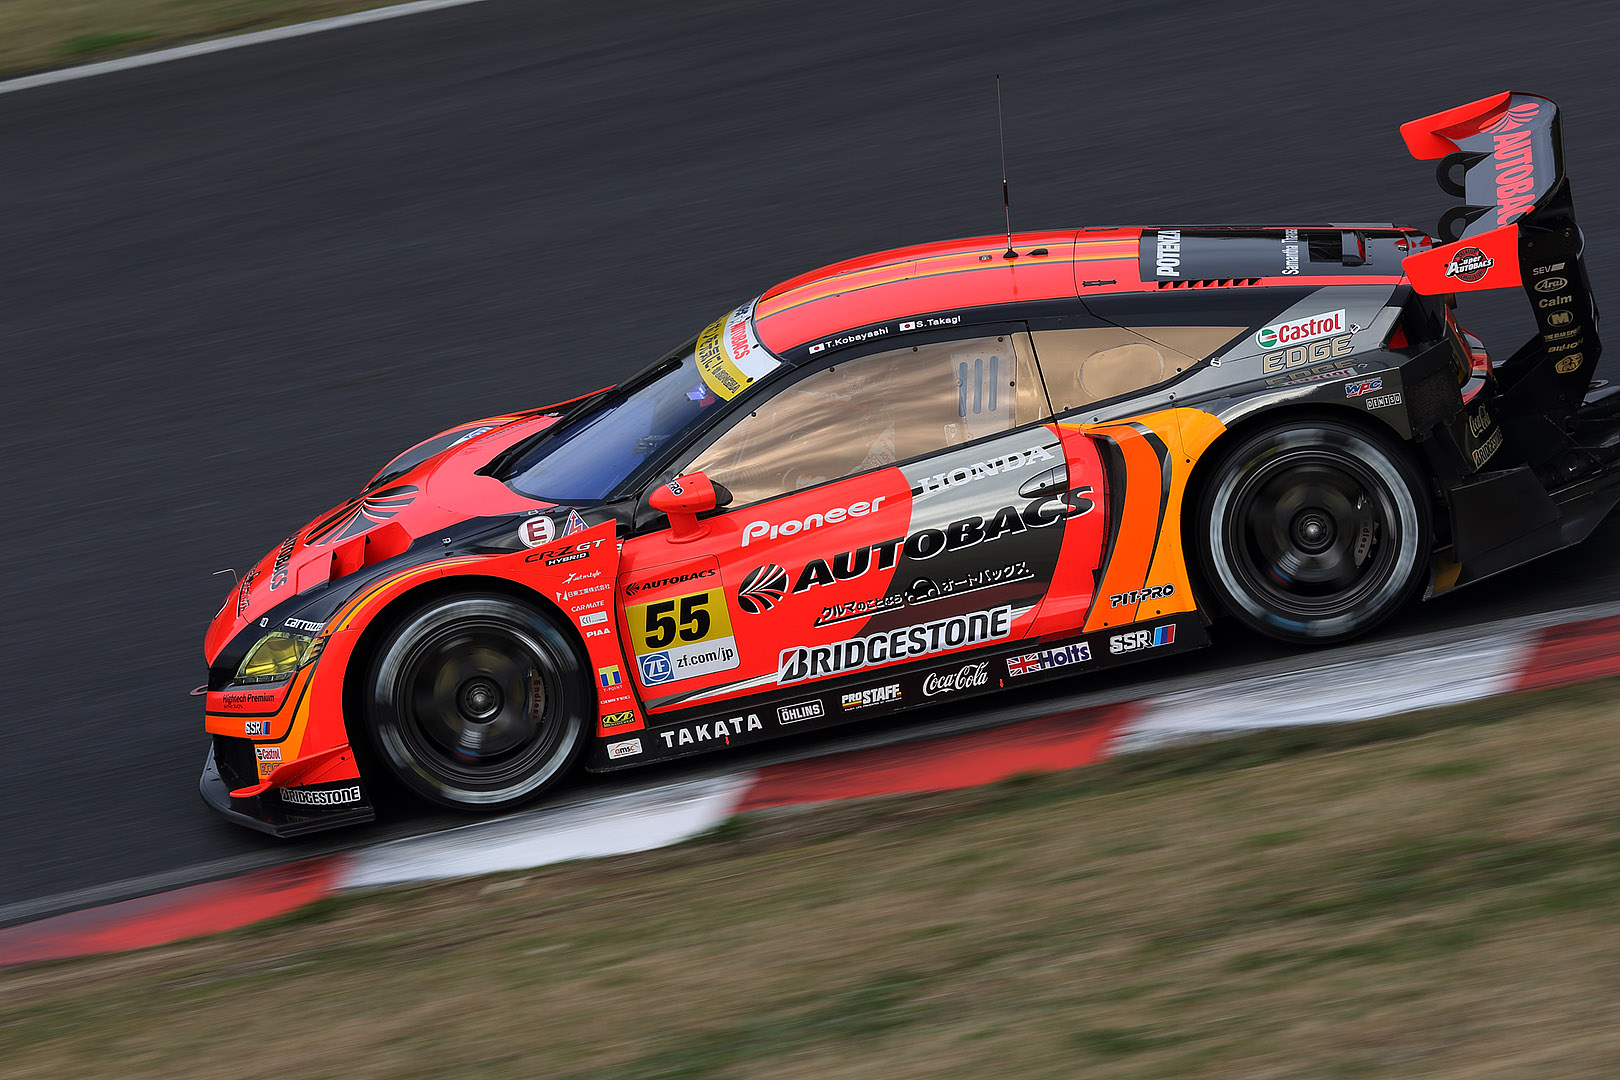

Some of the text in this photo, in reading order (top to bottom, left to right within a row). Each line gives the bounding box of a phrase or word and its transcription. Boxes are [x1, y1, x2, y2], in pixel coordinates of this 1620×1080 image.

[1156, 229, 1181, 277] POTENZA
[1533, 265, 1551, 275] SEV
[1539, 279, 1563, 289] Arai
[1538, 295, 1573, 308] Calm
[916, 315, 961, 329] S.Takagi
[1279, 313, 1341, 343] Castrol
[825, 327, 889, 349] T.Kobayashi
[1262, 334, 1355, 374] EDGE
[1345, 380, 1382, 396] WPC
[917, 445, 1055, 495] HONDA
[526, 519, 548, 542] E
[742, 496, 886, 548] Pioneer
[576, 538, 606, 551] GT
[792, 485, 1095, 595] AUTOBACS
[548, 552, 587, 566] HYBRID
[641, 568, 716, 591] AUTOBACS
[571, 600, 605, 612] CARMATE
[1109, 584, 1175, 608] PIT-PRO
[645, 593, 711, 649] 55
[586, 628, 611, 638] PIAA
[1110, 630, 1152, 655] SSR
[780, 606, 1010, 683] BRIDGESTONE
[677, 647, 734, 668] zf.com/jp
[1038, 645, 1090, 670] Holts
[923, 661, 990, 697] Coca-Cola
[222, 693, 275, 705] Hightech Premium
[841, 692, 862, 704] PRO
[863, 683, 900, 705] STAFF
[781, 704, 821, 721] ÖHLINS
[245, 721, 262, 736] SSR
[660, 713, 763, 748] TAKATA
[280, 786, 361, 805] BRIDGESTONE
